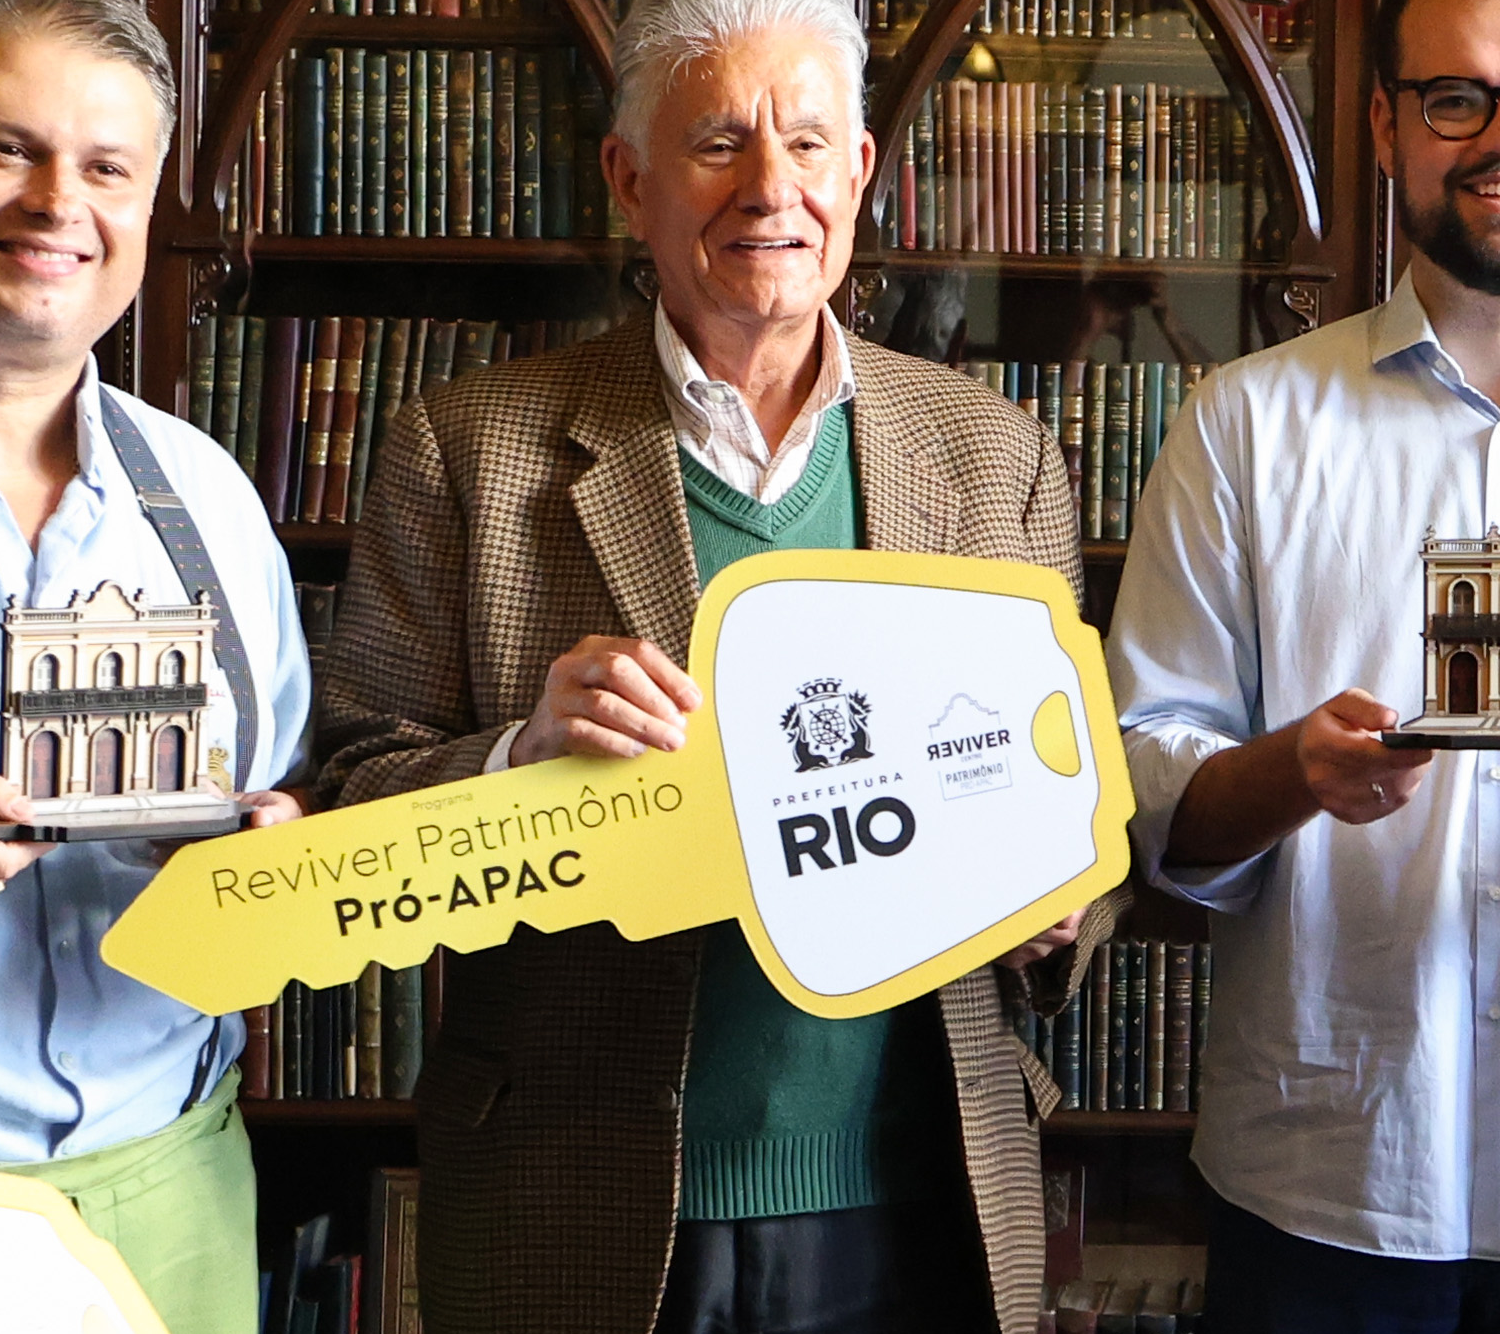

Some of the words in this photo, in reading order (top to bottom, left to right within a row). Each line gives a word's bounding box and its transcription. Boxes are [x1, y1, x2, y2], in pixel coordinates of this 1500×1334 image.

[411, 790, 473, 813] Programa
[772, 772, 903, 807] PREFEITURA
[945, 762, 1004, 785] PATRIMÔNIO
[211, 841, 398, 909] Reviver
[416, 777, 683, 864] Patrimônio
[777, 796, 916, 877] RIO
[334, 850, 586, 937] Pró-APAC
